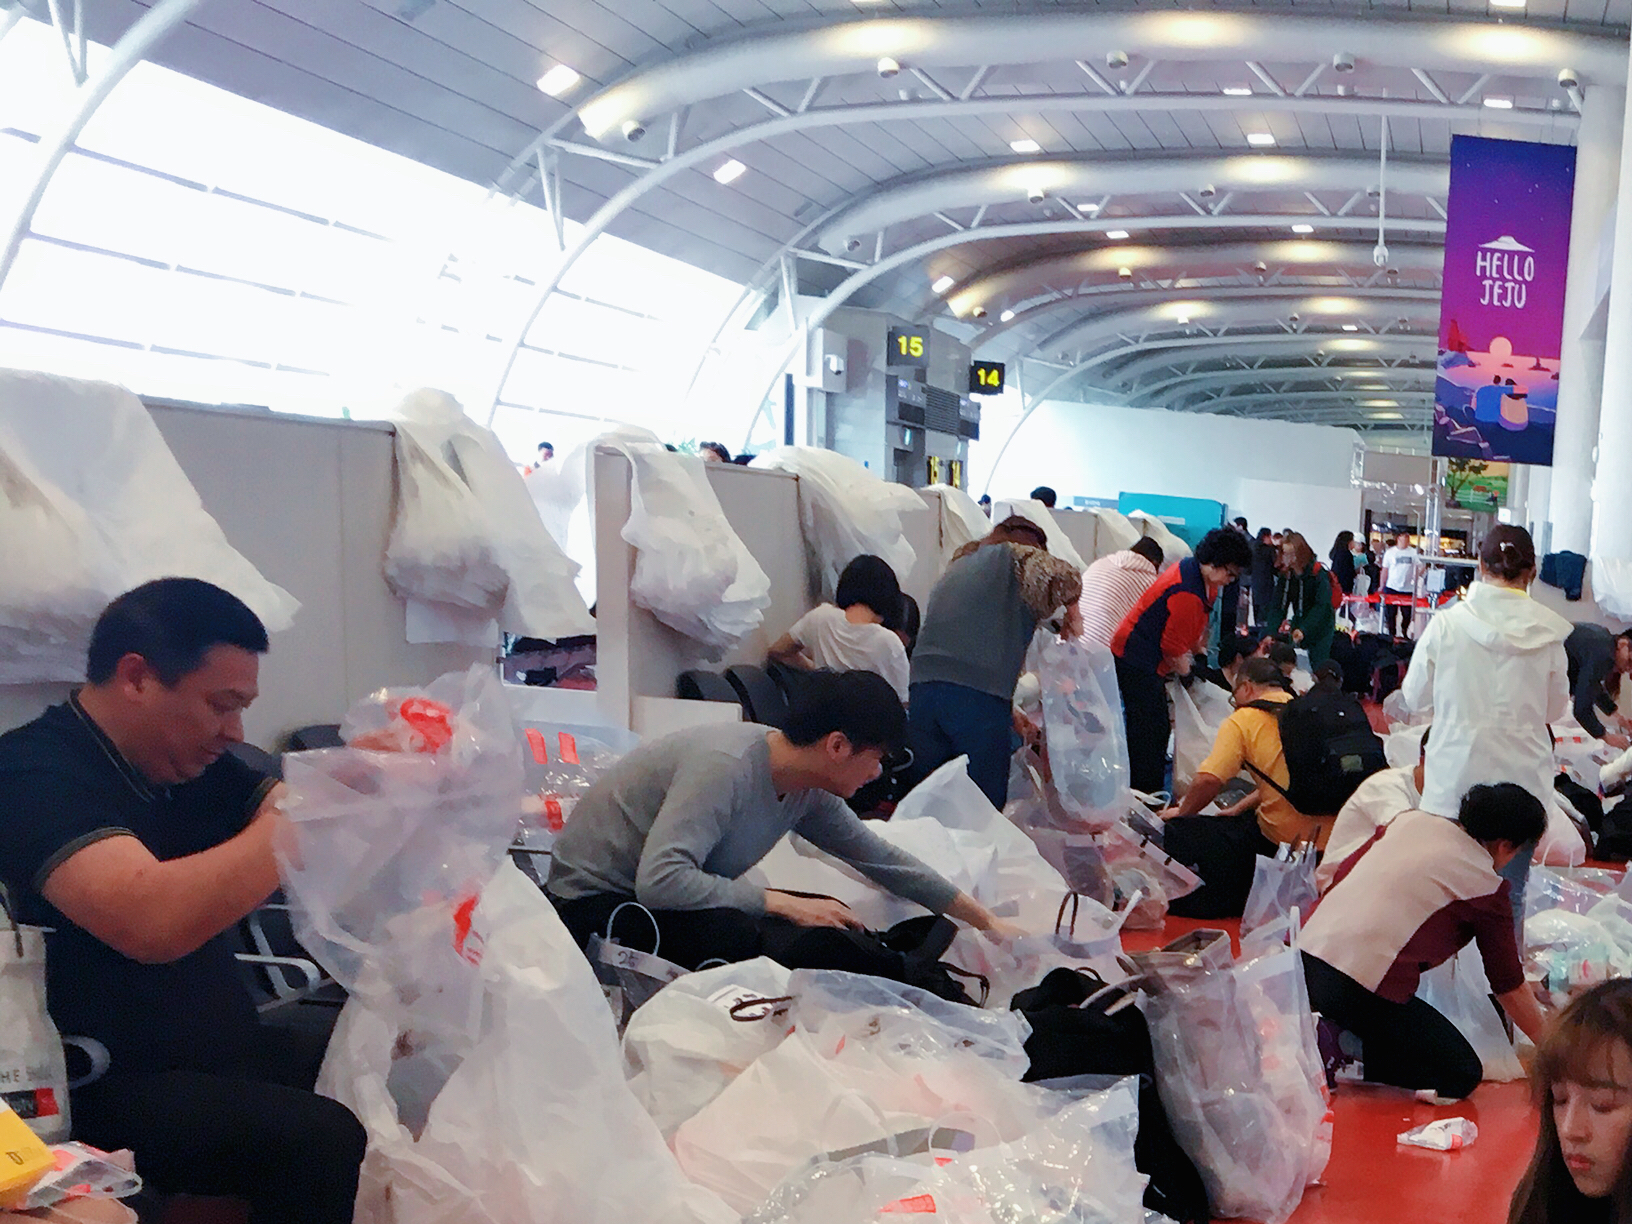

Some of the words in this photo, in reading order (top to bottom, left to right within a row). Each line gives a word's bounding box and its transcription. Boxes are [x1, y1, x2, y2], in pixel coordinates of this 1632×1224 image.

[1476, 251, 1534, 282] HELLO
[1480, 280, 1526, 309] JEJU
[898, 335, 923, 357] 15
[977, 368, 1000, 387] 14
